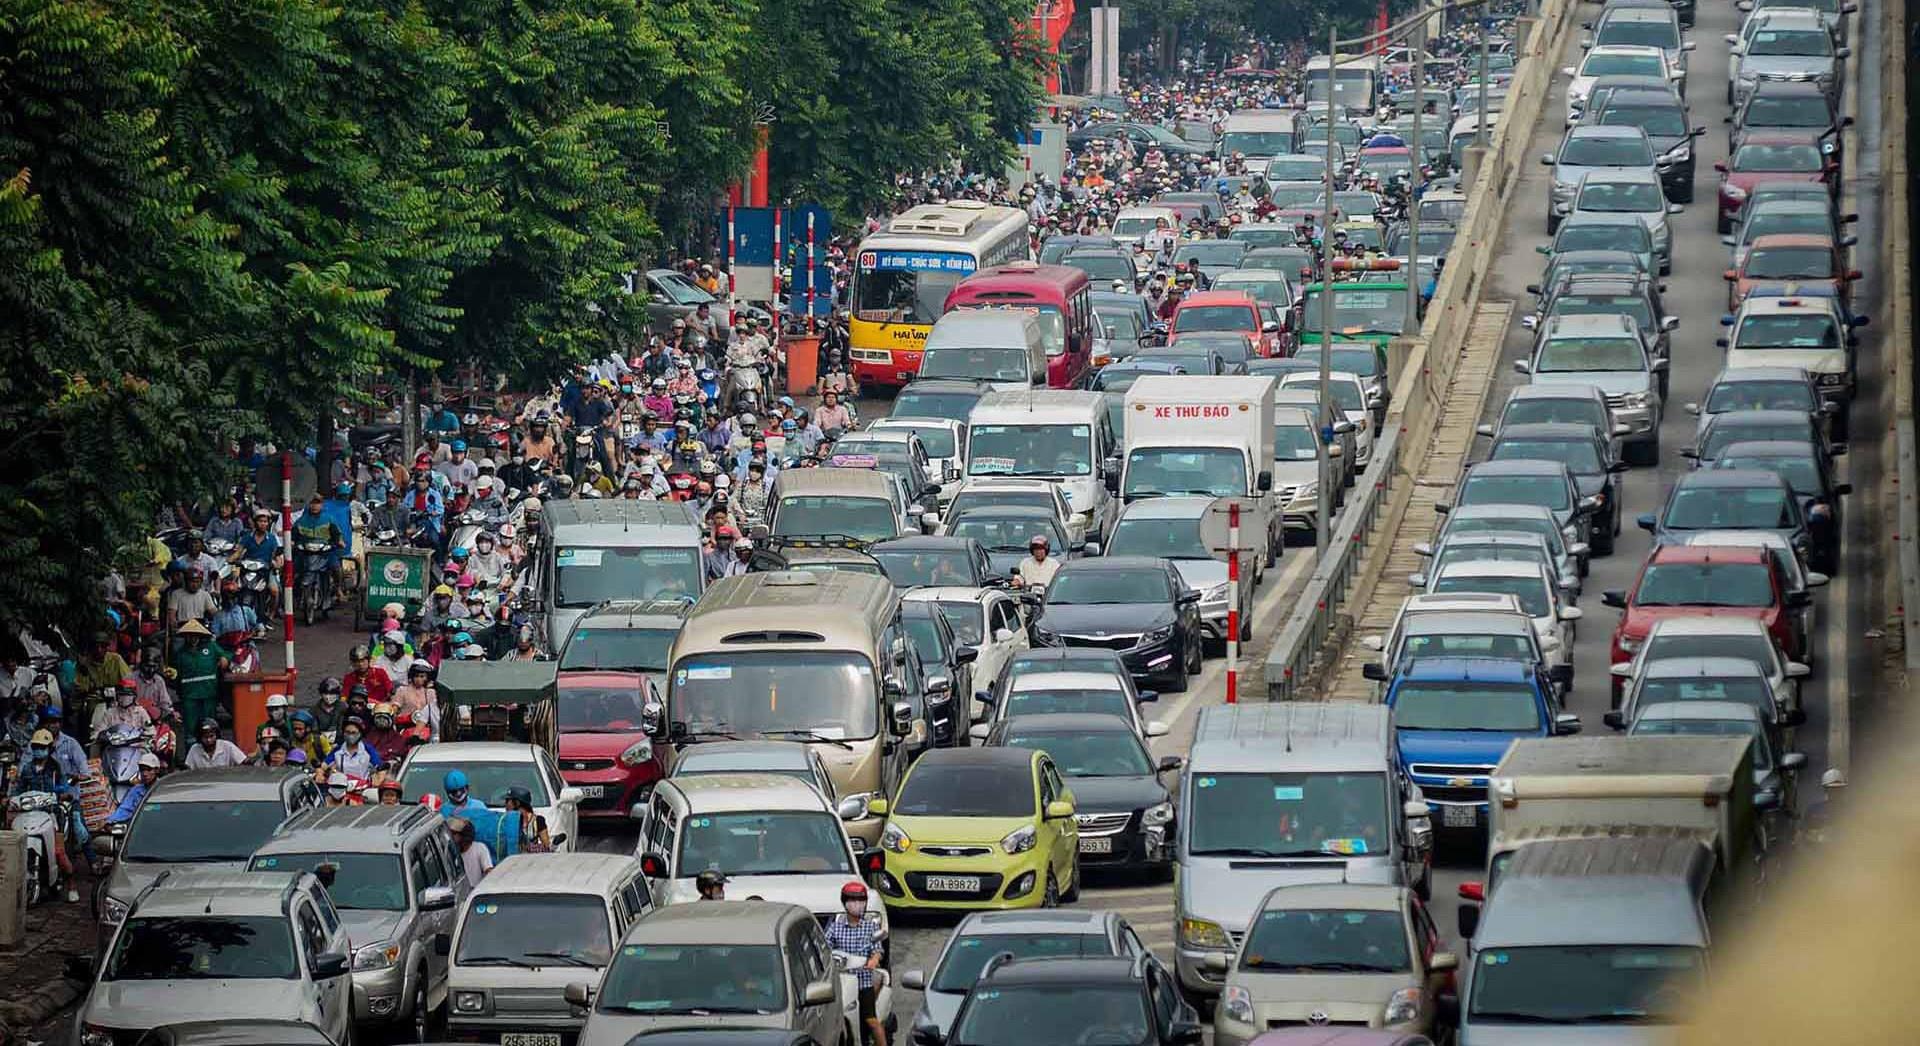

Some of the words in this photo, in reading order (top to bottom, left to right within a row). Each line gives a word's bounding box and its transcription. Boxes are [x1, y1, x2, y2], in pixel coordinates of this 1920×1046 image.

[862, 254, 875, 266] 80
[1155, 407, 1171, 417] XE
[1176, 406, 1200, 417] THƯ
